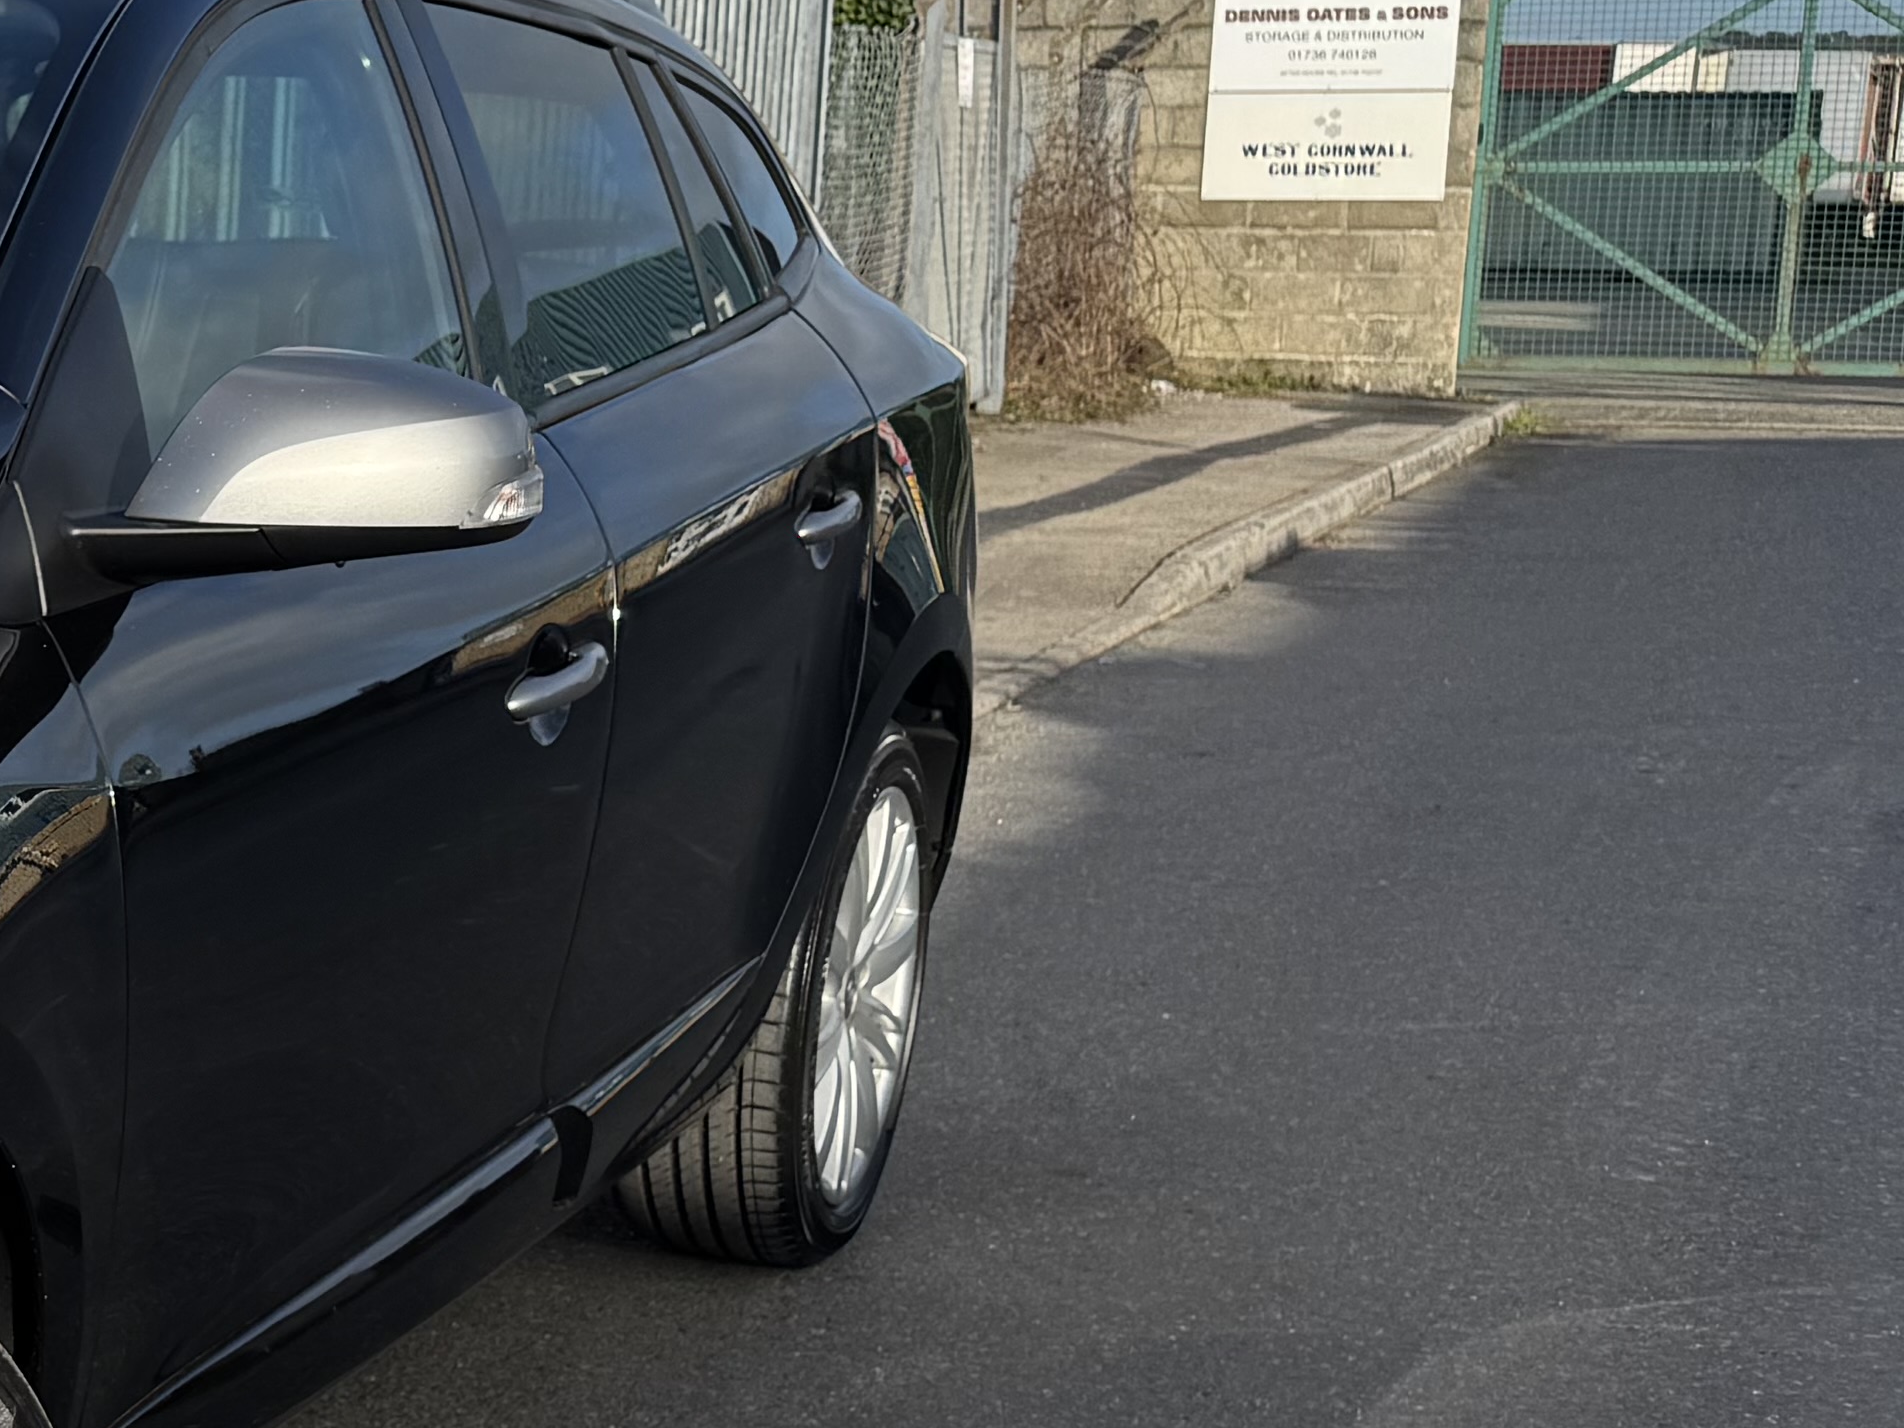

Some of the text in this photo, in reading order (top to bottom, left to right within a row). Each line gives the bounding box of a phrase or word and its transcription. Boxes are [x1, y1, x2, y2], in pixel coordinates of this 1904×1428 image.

[1225, 8, 1300, 23] DENNIS
[1392, 5, 1449, 21] SONS
[1245, 30, 1309, 44] STORAGE
[1326, 28, 1425, 42] DISTRIBUTION
[1242, 142, 1298, 159] WEST
